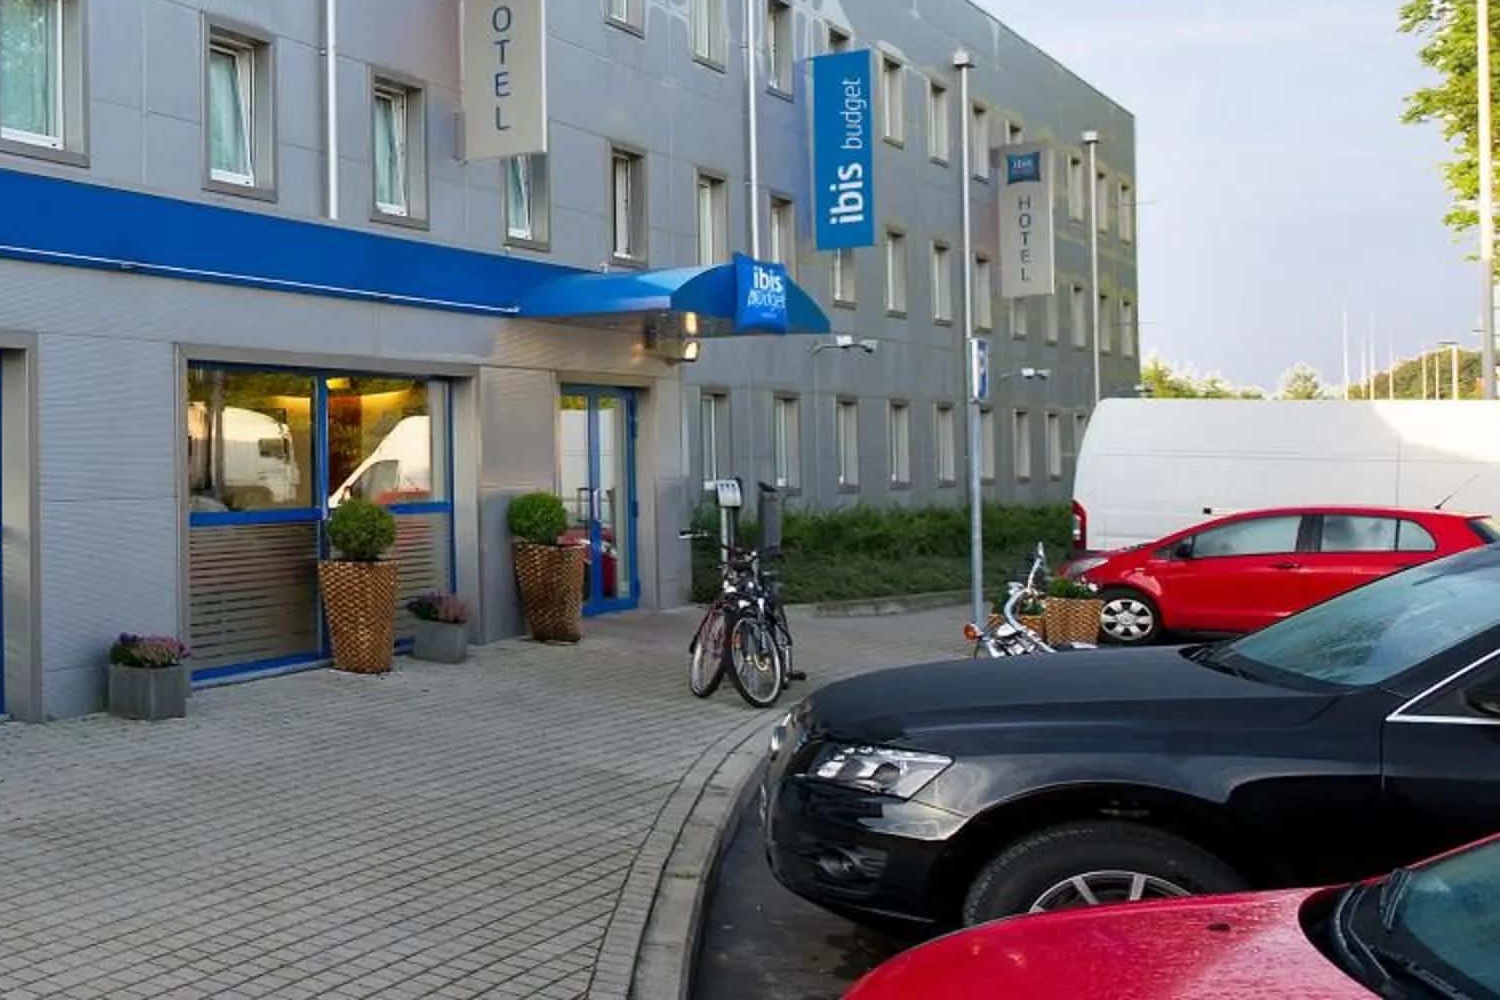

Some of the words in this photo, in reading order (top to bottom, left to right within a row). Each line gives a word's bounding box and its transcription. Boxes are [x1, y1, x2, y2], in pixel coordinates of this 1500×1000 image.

[840, 77, 867, 150] budget
[830, 162, 865, 225] ibis
[1018, 195, 1032, 282] HOTEL
[753, 265, 783, 293] ibis
